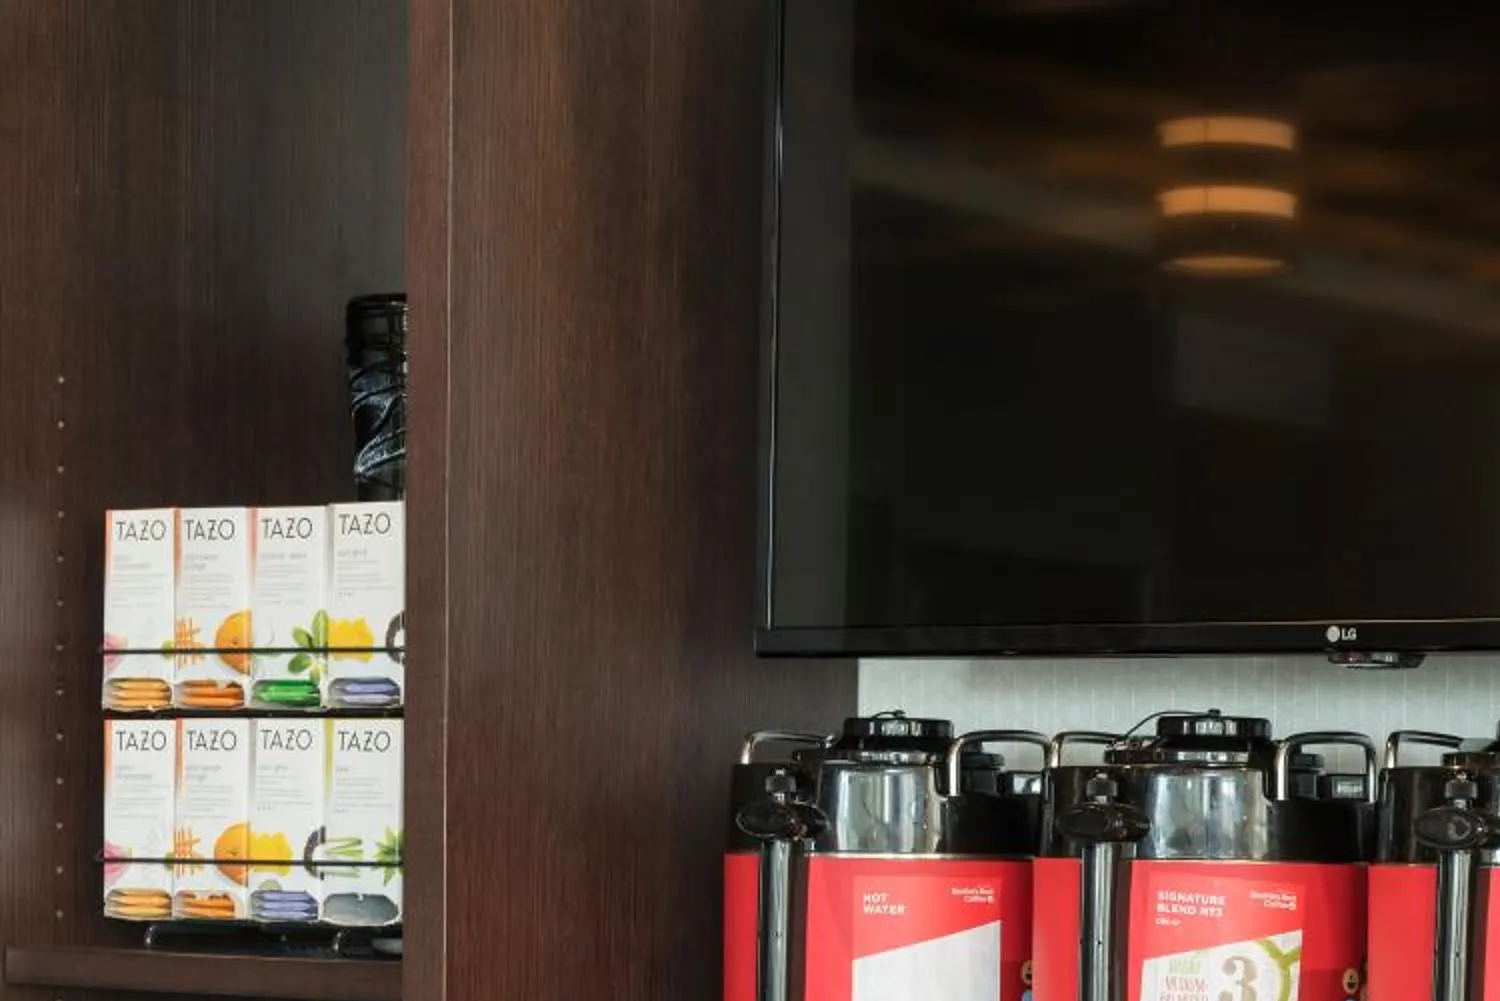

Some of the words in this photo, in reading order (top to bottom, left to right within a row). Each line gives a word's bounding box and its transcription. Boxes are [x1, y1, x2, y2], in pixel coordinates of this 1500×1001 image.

[115, 519, 167, 542] TAZO
[184, 518, 236, 542] TAZO
[262, 517, 314, 540] TAZO
[338, 512, 392, 535] TAZO
[1341, 627, 1358, 641] LG
[115, 729, 168, 752] TAZO
[186, 729, 238, 752] TAZO
[260, 728, 313, 752] TAZO
[337, 730, 391, 753] TAZO
[863, 893, 889, 903] HOT
[863, 904, 906, 915] WATER
[1157, 890, 1226, 906] SIGNATURE
[1156, 904, 1197, 916] BLEND
